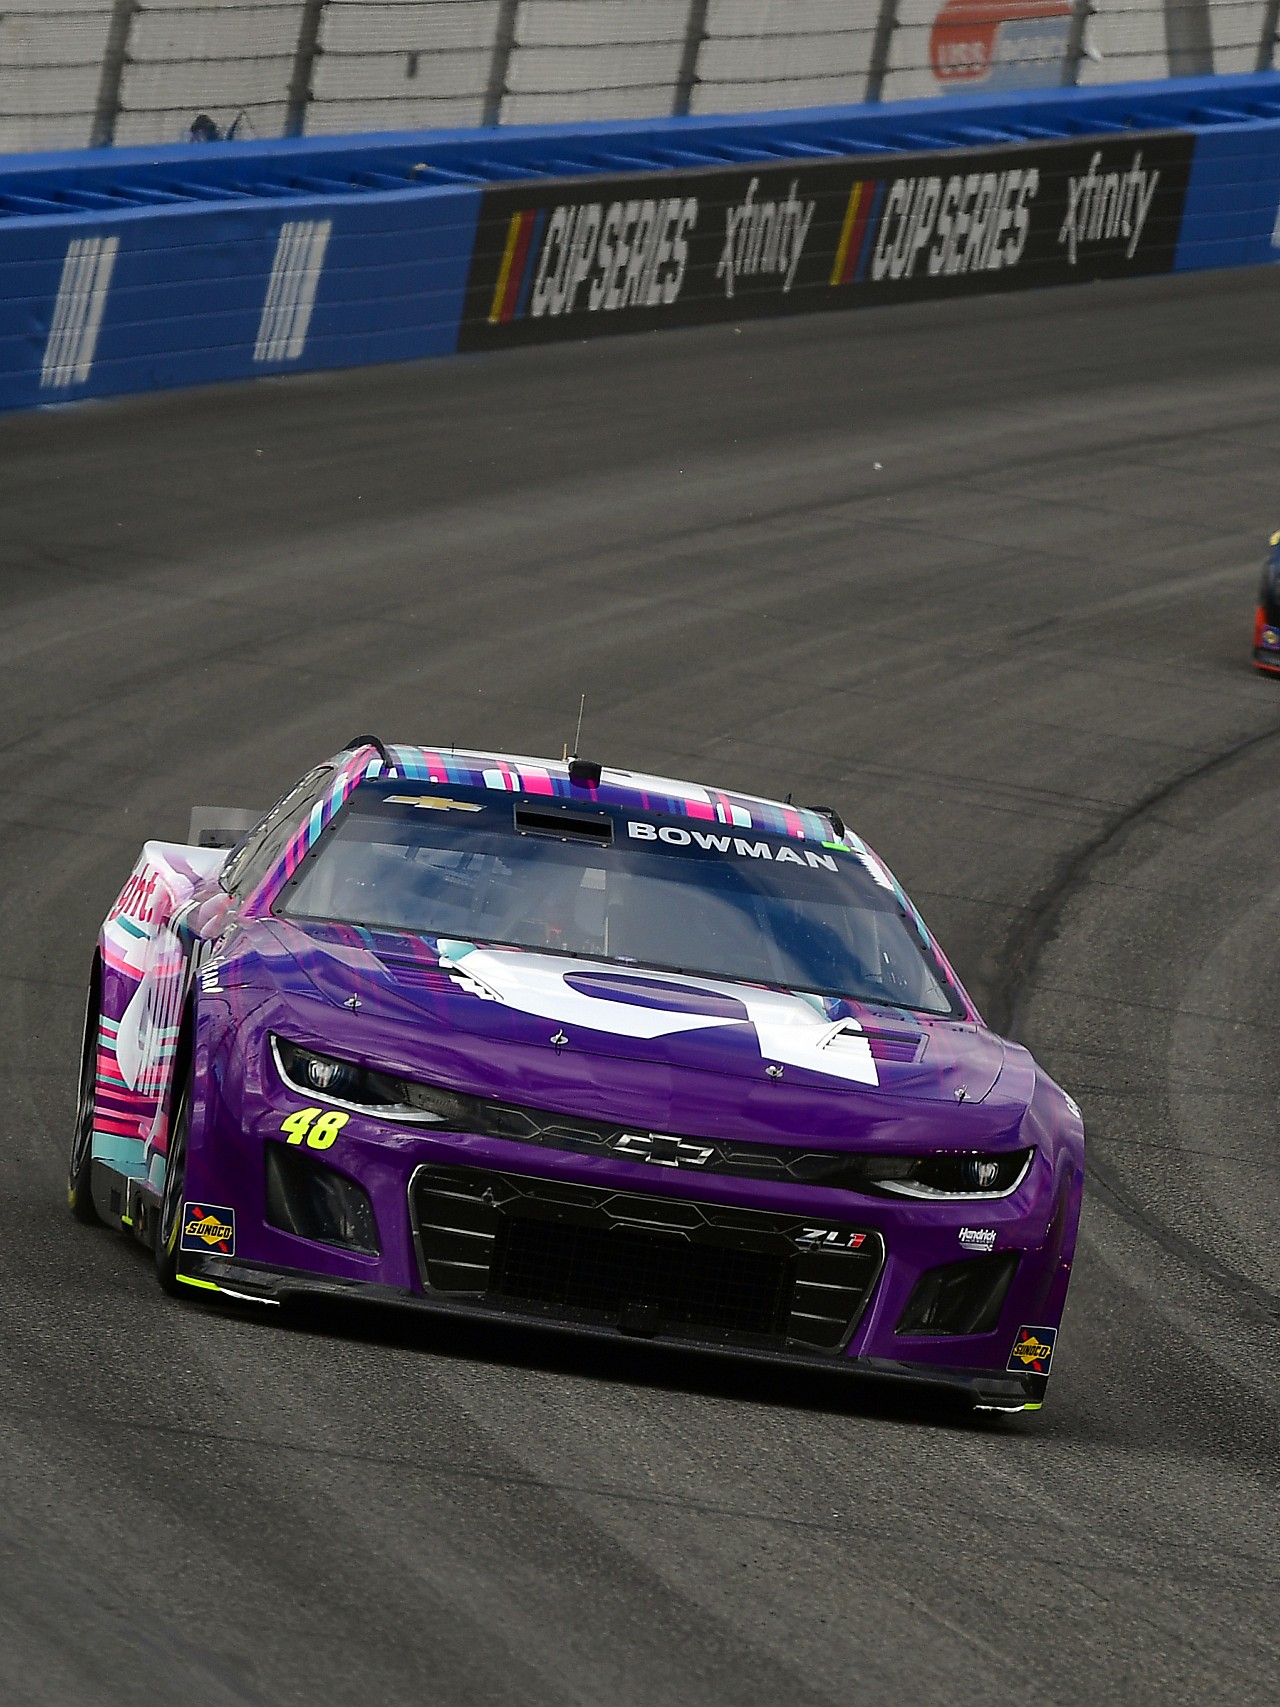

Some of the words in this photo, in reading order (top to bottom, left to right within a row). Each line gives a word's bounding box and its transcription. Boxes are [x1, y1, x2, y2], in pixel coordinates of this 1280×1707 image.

[872, 175, 942, 281] CUP
[928, 168, 1039, 278] SERIES
[531, 202, 603, 318] CUP
[588, 197, 698, 312] SERIES
[627, 821, 839, 873] BOWMAN
[279, 1107, 350, 1150] 48
[187, 1222, 231, 1238] SUNOCO
[958, 1227, 997, 1243] Hendrick
